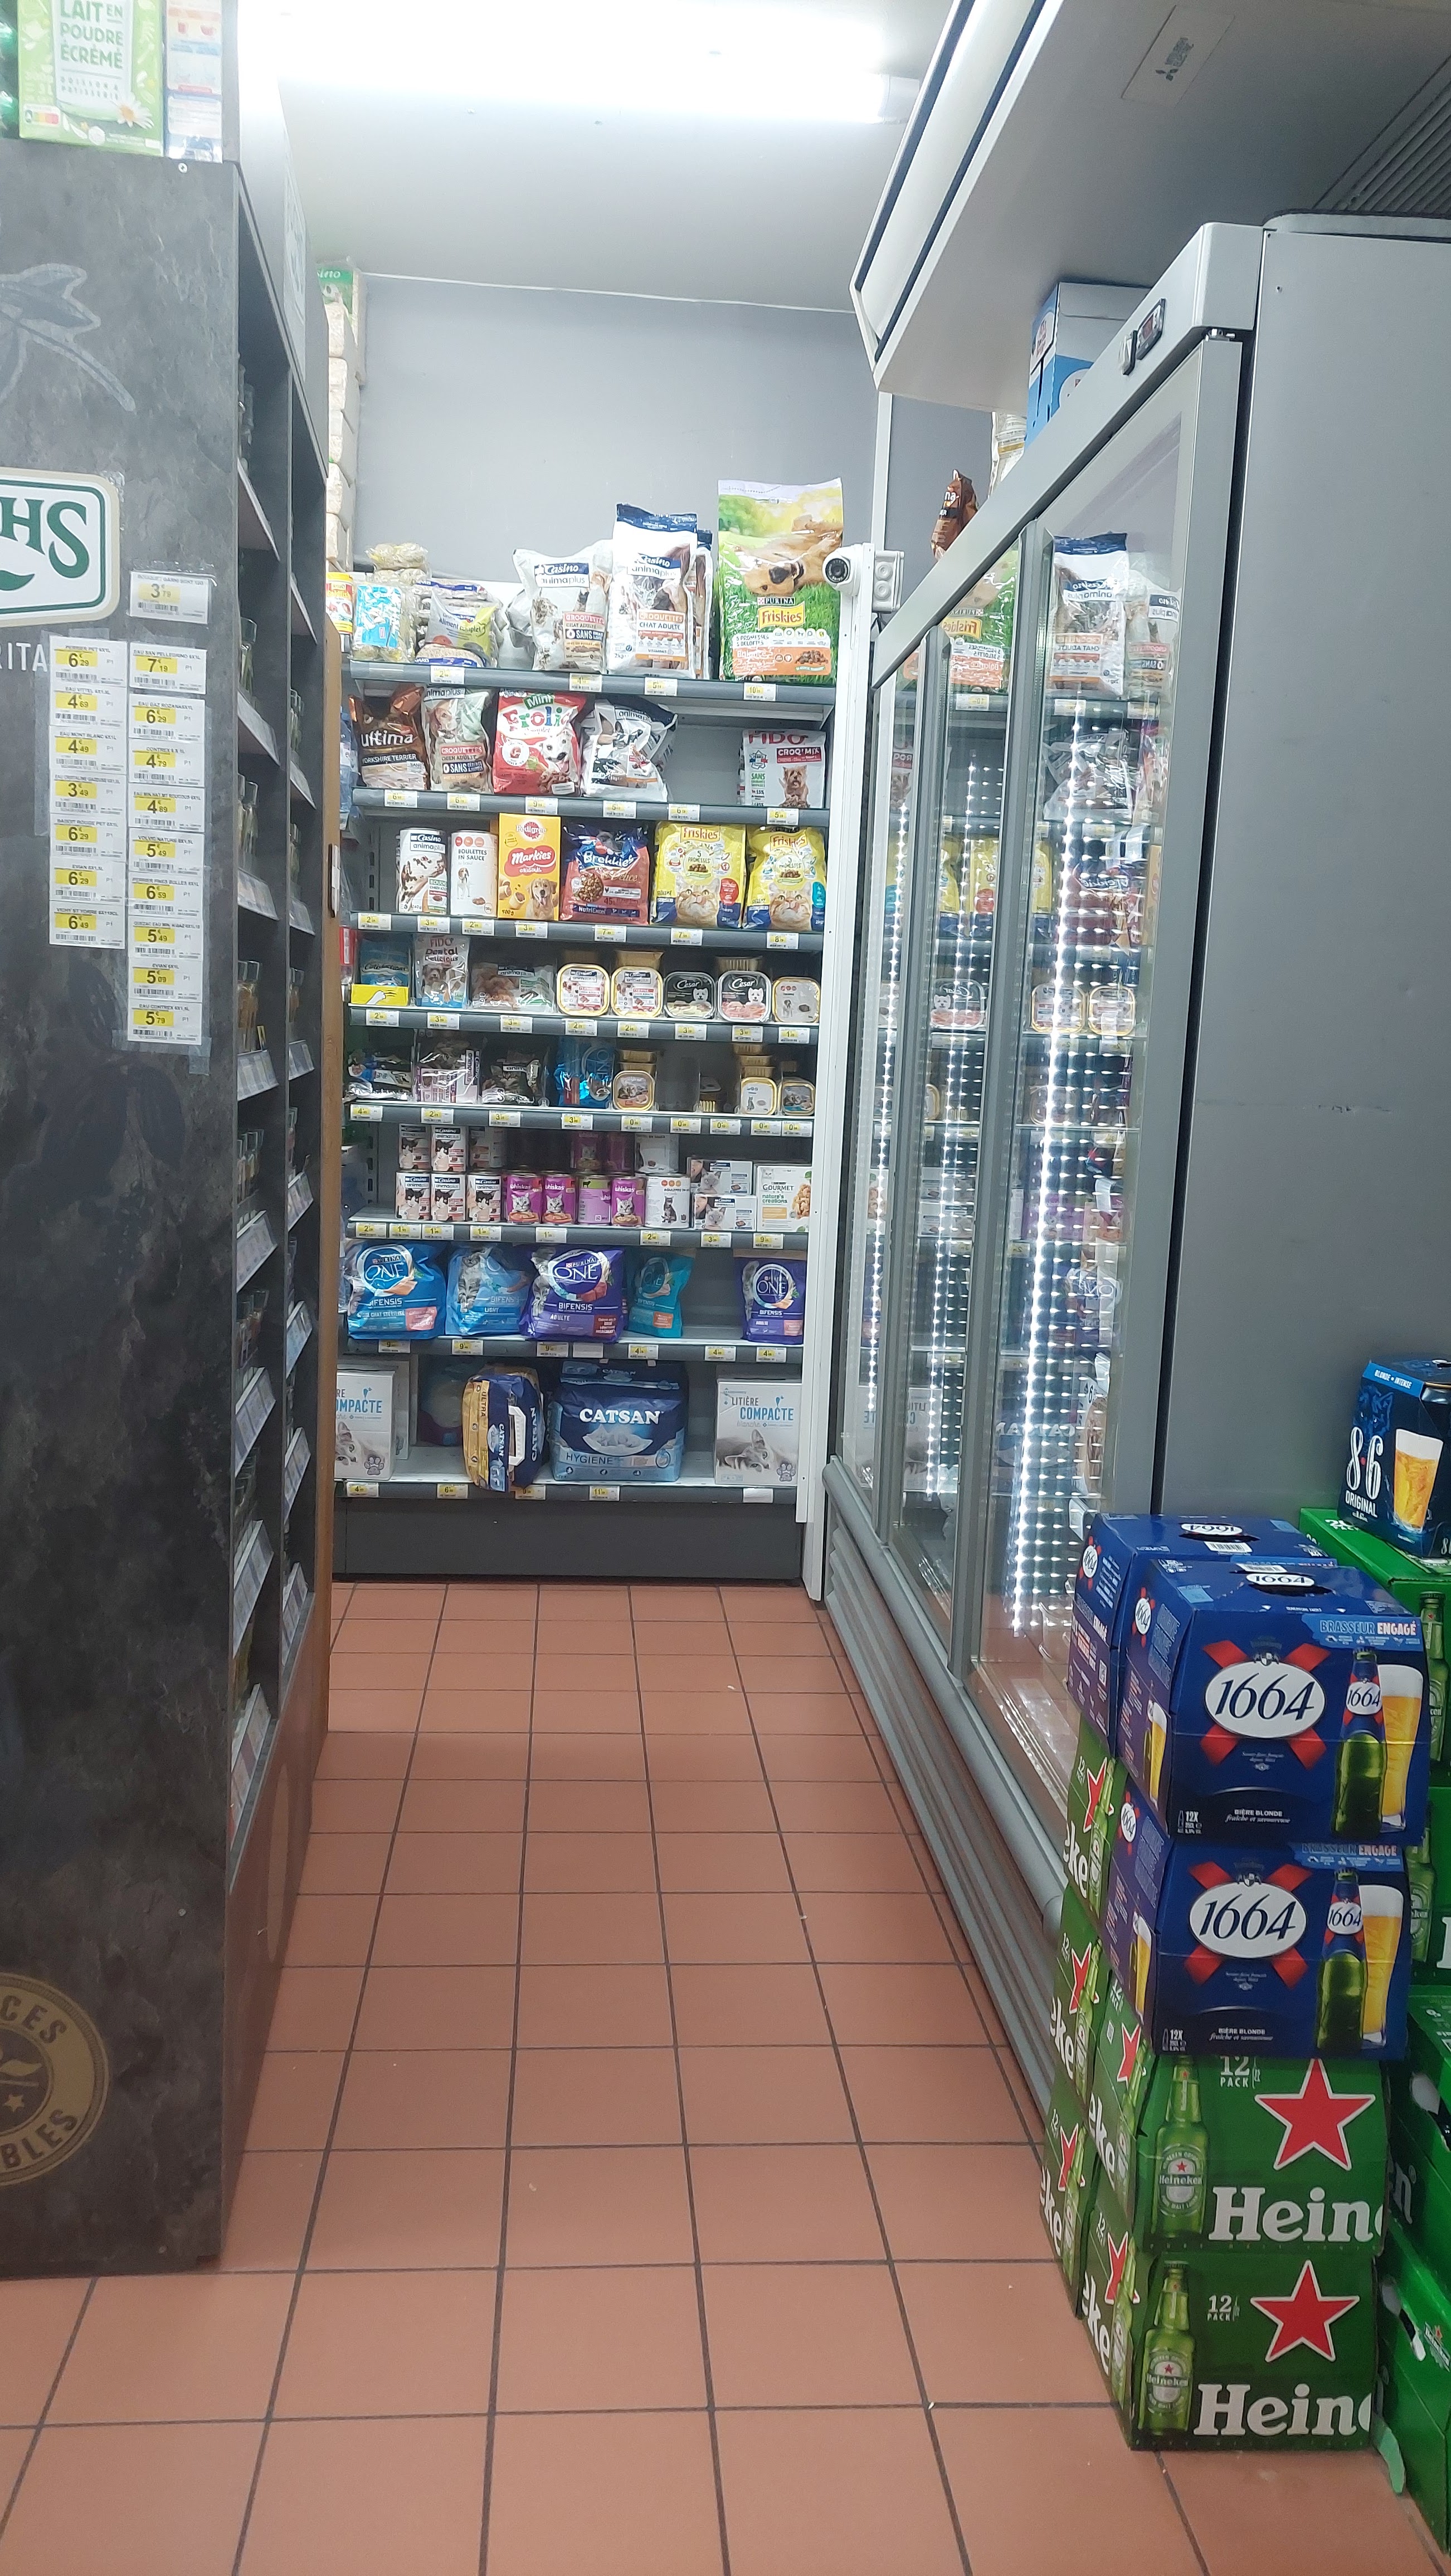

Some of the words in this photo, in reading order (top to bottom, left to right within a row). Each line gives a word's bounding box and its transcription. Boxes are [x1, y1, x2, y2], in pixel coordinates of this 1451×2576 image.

[60, 0, 103, 22] LAIT
[106, 4, 123, 18] EN
[60, 22, 123, 46] POUDRE
[762, 610, 802, 625] Friskies
[576, 630, 593, 640] SANS
[0, 642, 47, 672] ITA
[426, 688, 461, 697] nimaplus
[528, 694, 554, 708] Mini
[503, 706, 572, 732] Frolic
[361, 730, 413, 747] ultima
[748, 731, 808, 745] FIDO
[441, 746, 482, 754] CROQUETTES
[362, 755, 391, 764] YORKSHIRE
[450, 763, 468, 773] SANS
[683, 826, 718, 840] Friskies
[772, 837, 807, 847] Friskies
[511, 850, 552, 865] Markies
[583, 851, 634, 868] Brekkies
[430, 938, 453, 947] FIDO
[425, 947, 459, 955] Dental
[676, 979, 700, 989] Cesar
[732, 979, 755, 989] Cesar
[573, 1258, 596, 1267] PURINA
[365, 1263, 403, 1281] ONE
[554, 1265, 598, 1280] ONE
[757, 1280, 786, 1295] ONE
[558, 1302, 593, 1311] BIFENSIS
[1374, 1369, 1391, 1382] BLONDE
[1394, 1377, 1413, 1389] INTENSE
[337, 1399, 382, 1413] MPACTE
[731, 1395, 759, 1406] LITIÈRE
[579, 1408, 660, 1424] CATSAN
[740, 1407, 794, 1421] COMPACTE
[566, 1452, 613, 1465] HYGIENE
[1345, 1489, 1378, 1518] ORIGINAL
[1083, 1549, 1098, 1574] 1664
[1255, 1574, 1306, 1584] 1664
[1136, 1603, 1151, 1629] 1664
[1319, 1620, 1376, 1635] BRASSEUR
[1377, 1620, 1417, 1636] ENGAGÉ
[1215, 1672, 1316, 1720] 1664
[1347, 1683, 1381, 1707] 1664
[1121, 1808, 1136, 1838] 1664
[1185, 1811, 1199, 1823] 12X
[1199, 1893, 1298, 1940] 1664
[1328, 1905, 1363, 1927] 1664
[1170, 2029, 1184, 2041] 12X
[1220, 2056, 1250, 2076] 12
[1220, 2077, 1249, 2088] PACK
[1159, 2174, 1202, 2185] Heineken
[1208, 2295, 1232, 2312] 12
[1207, 2312, 1231, 2321] PACK
